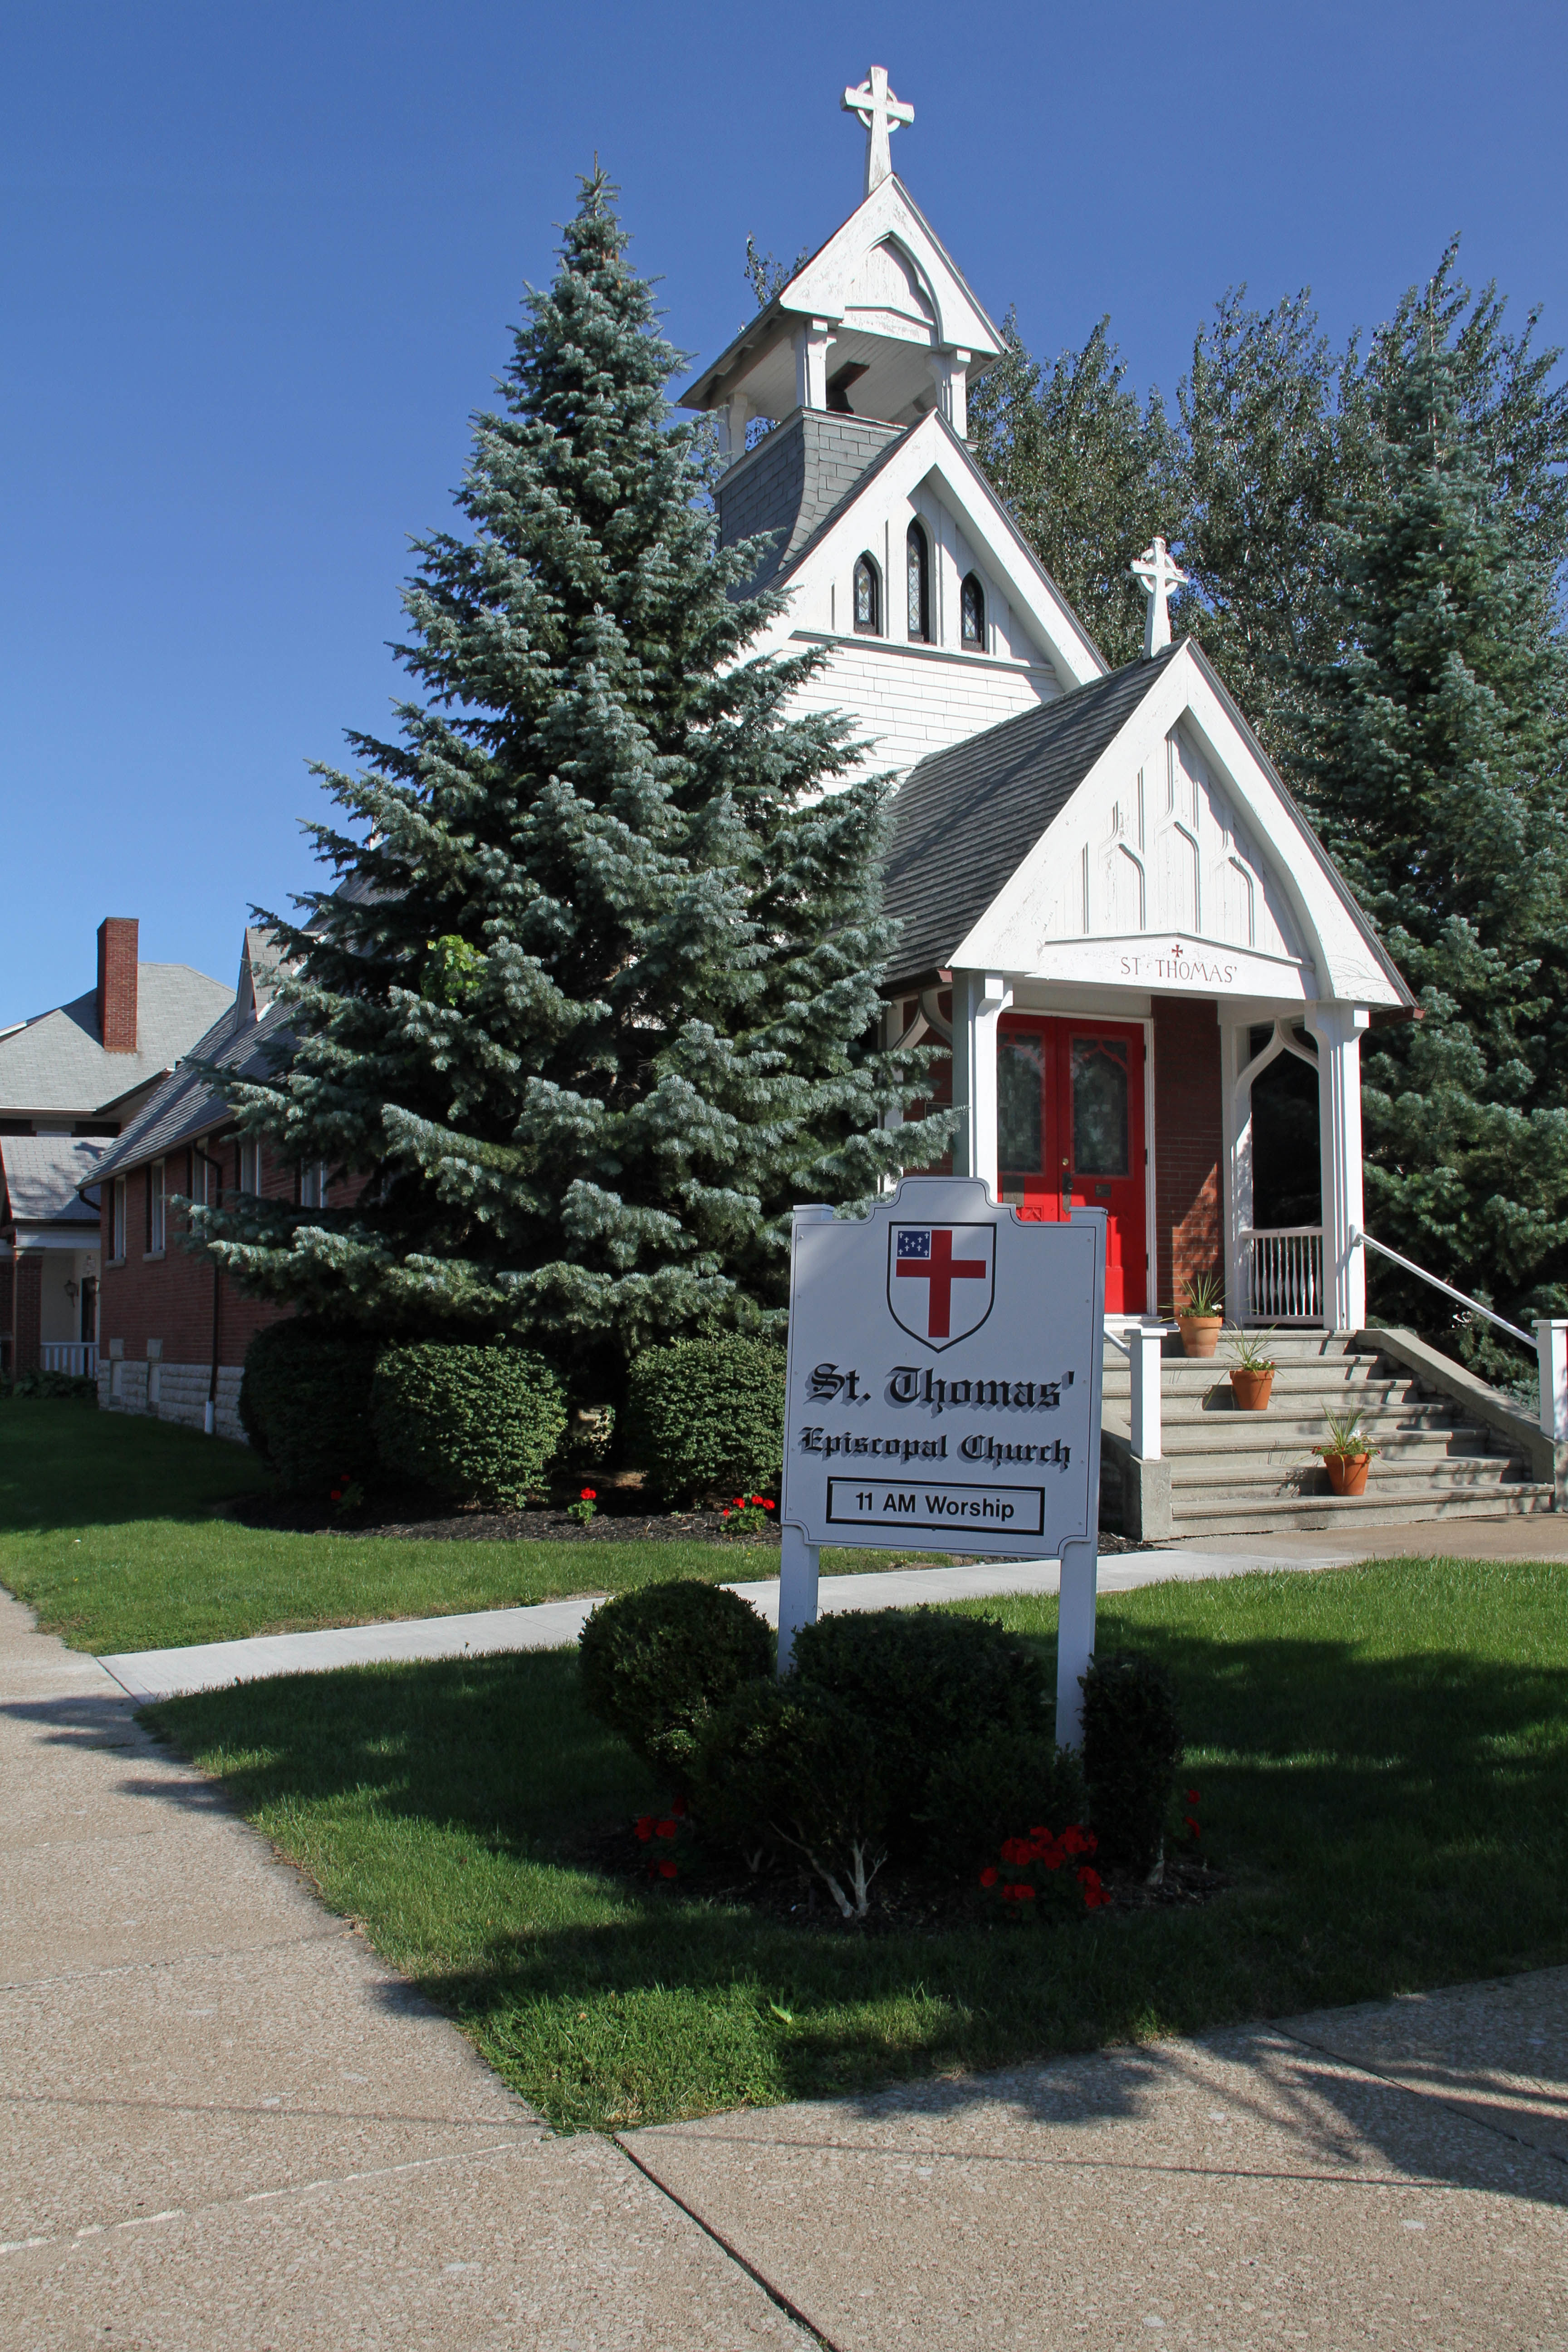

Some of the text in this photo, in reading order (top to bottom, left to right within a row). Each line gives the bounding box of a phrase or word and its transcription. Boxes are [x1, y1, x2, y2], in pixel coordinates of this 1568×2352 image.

[1155, 959, 1237, 983] THOMAS'
[810, 1362, 1075, 1413] St. Thomas'
[801, 1426, 1072, 1470] Episcopal Church
[855, 1492, 1014, 1522] 11 AM Worship
